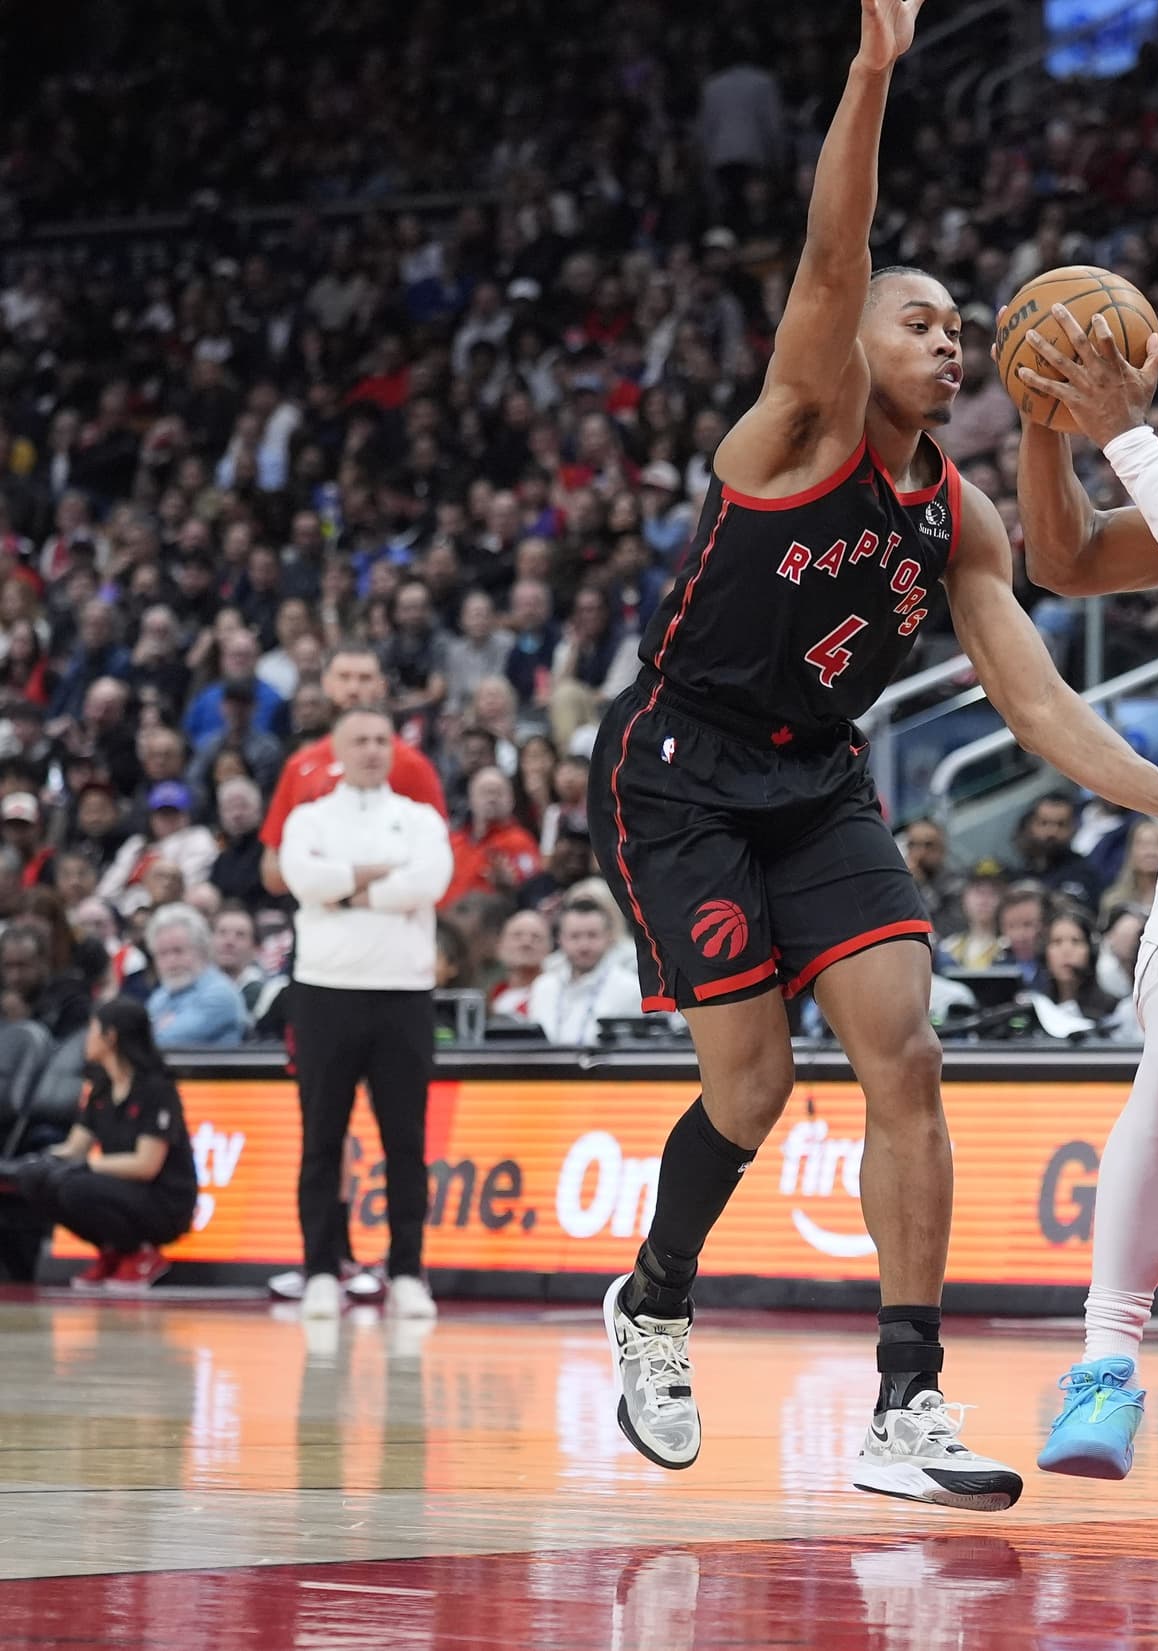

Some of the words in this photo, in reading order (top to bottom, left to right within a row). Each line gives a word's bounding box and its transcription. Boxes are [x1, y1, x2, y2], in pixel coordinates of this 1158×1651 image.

[918, 522, 932, 536] Sun
[933, 527, 950, 541] Life
[776, 528, 928, 637] RAPTORS
[803, 613, 870, 689] 4
